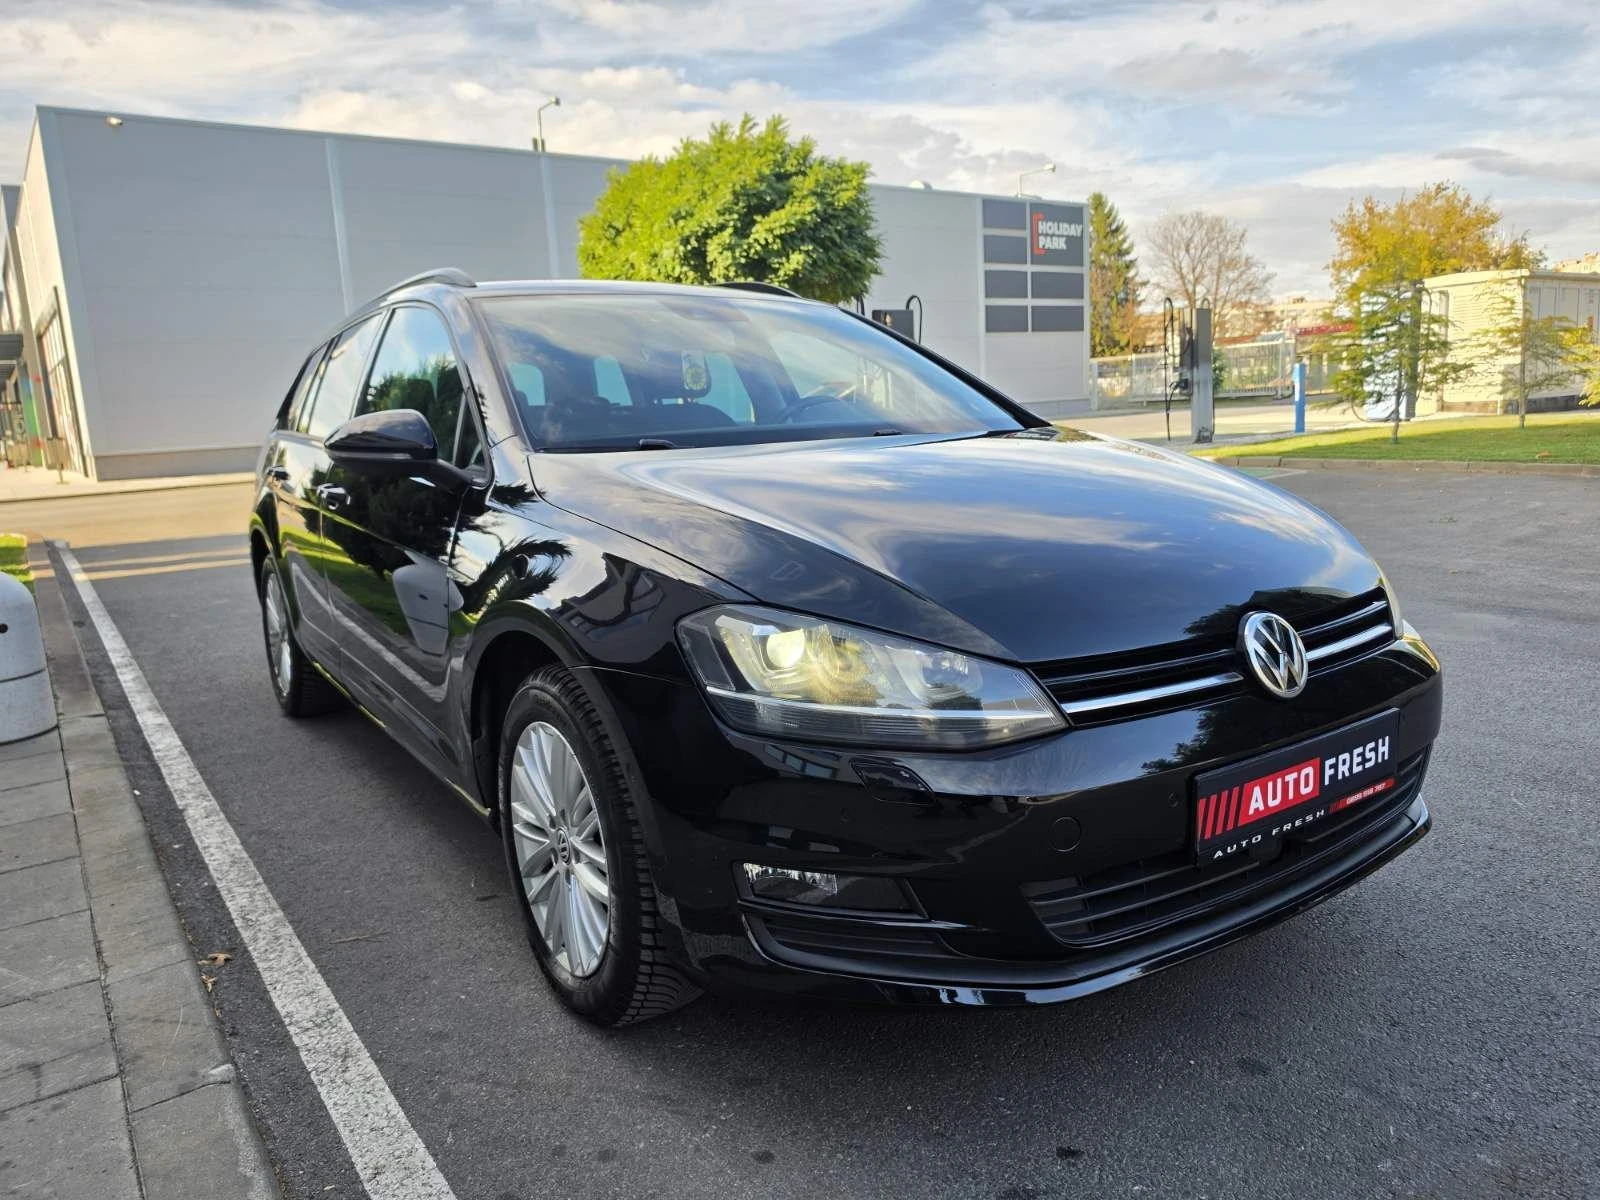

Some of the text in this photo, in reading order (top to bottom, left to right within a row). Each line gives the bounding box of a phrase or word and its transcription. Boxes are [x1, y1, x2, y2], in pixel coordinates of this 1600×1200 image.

[1038, 220, 1083, 237] HOLIDAY
[1038, 236, 1067, 250] PARK
[1248, 766, 1314, 816] AUTO
[1324, 735, 1389, 785] FRESH
[1213, 809, 1325, 860] AUTO FRESH
